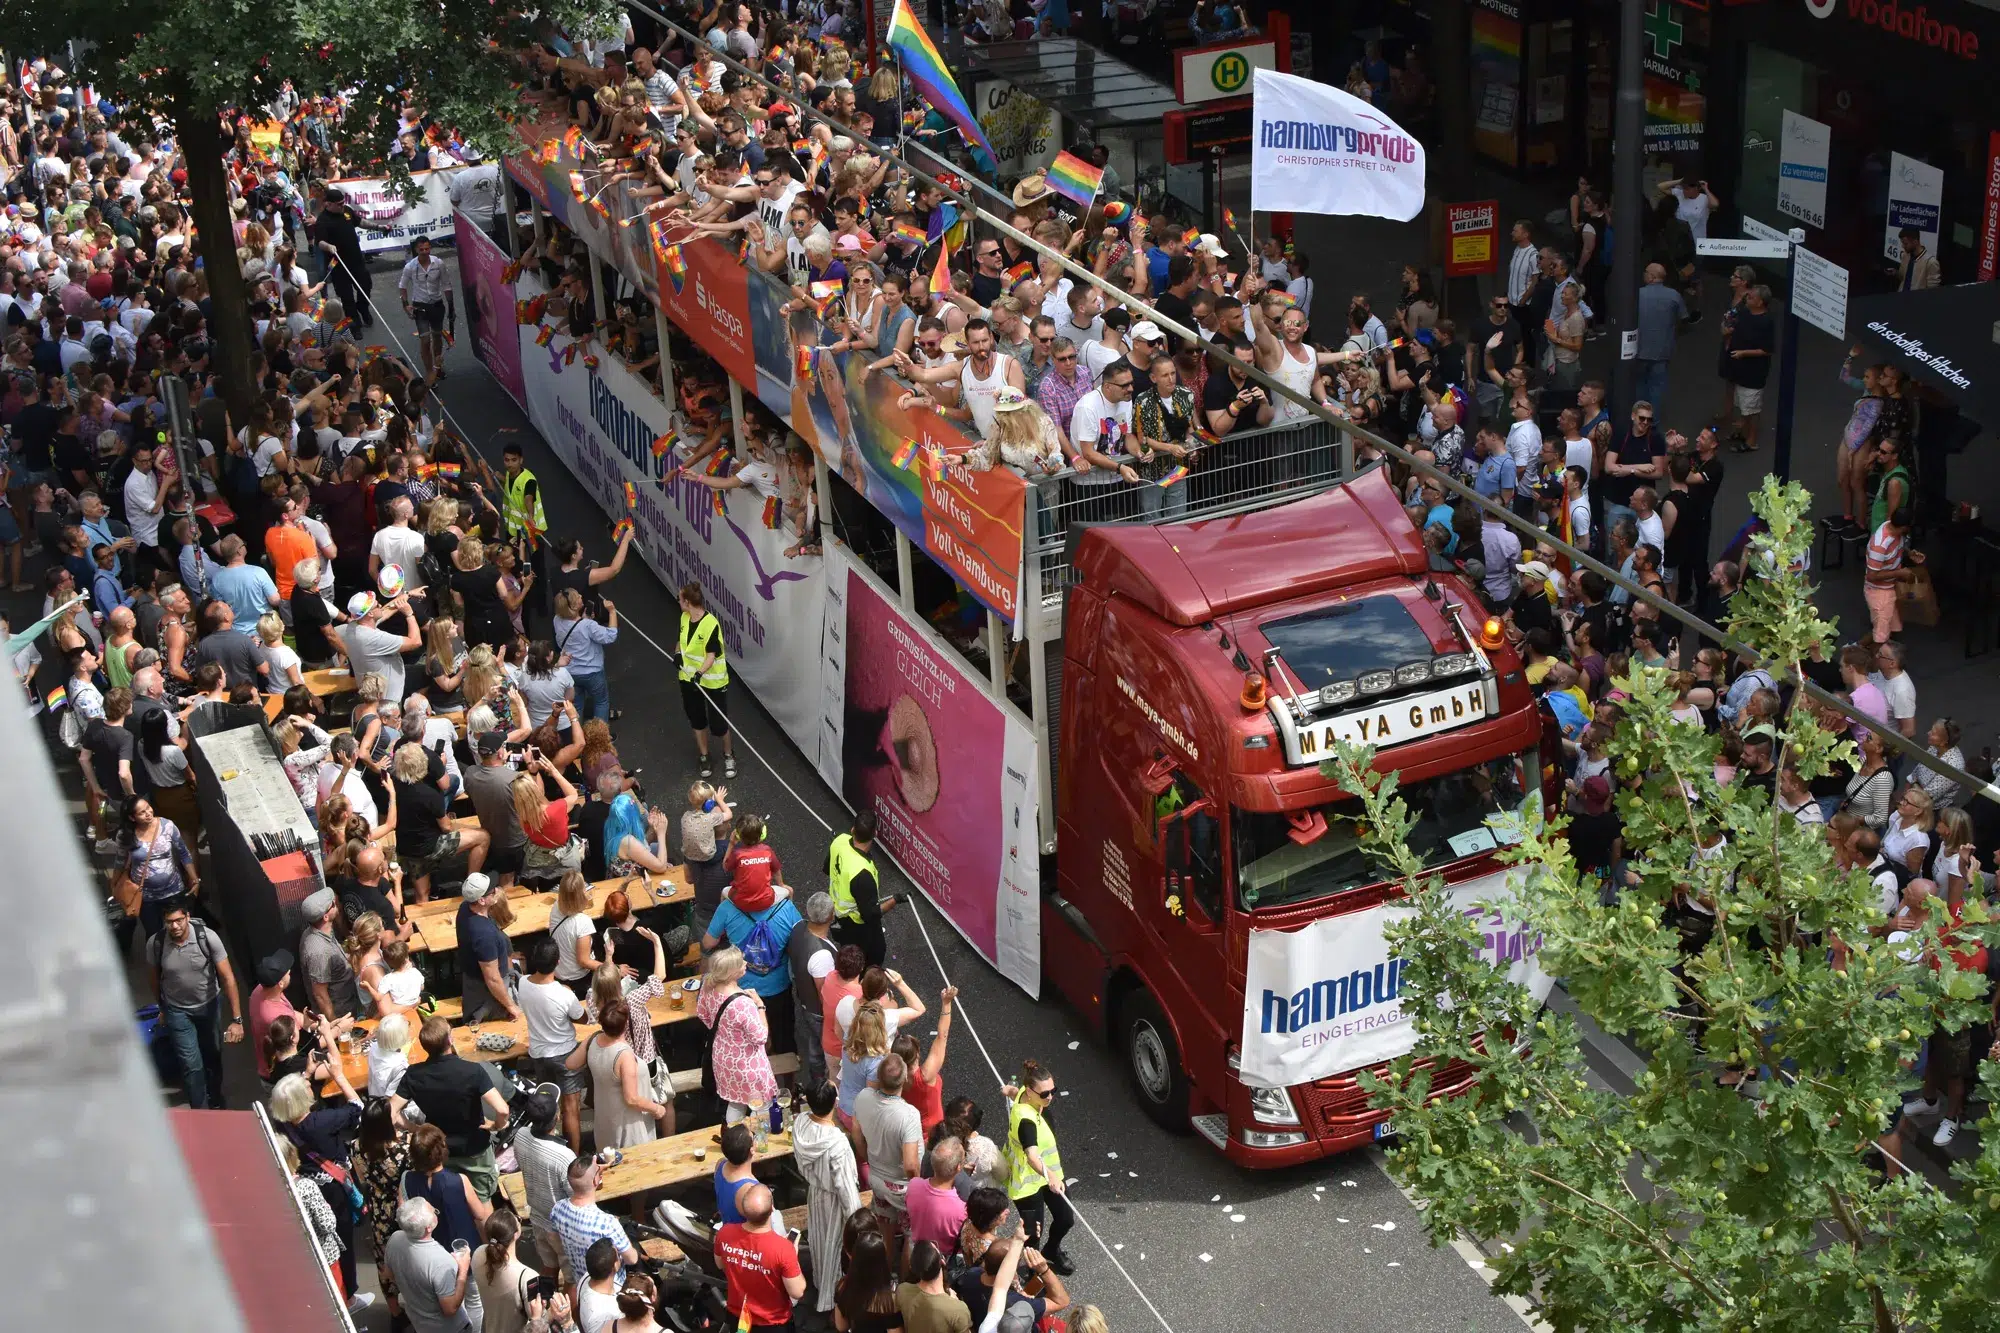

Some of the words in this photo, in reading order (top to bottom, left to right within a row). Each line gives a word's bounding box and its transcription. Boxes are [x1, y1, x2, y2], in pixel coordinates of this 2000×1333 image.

[1848, 0, 1980, 60] vodafone
[1643, 57, 1681, 80] HARMACY
[1260, 119, 1416, 164] hamburgpride
[1277, 155, 1341, 167] CHRISTOPHER
[1343, 158, 1377, 171] STREET
[1380, 164, 1396, 173] DAY
[1783, 165, 1791, 175] Zu
[1793, 167, 1825, 180] vermieten
[1989, 156, 2000, 198] Store
[354, 191, 369, 205] bin
[760, 200, 765, 219] I
[764, 205, 783, 229] AM
[1450, 207, 1476, 220] Hier
[1477, 205, 1493, 218] ist
[1780, 200, 1790, 211] 46
[1792, 204, 1801, 215] 09
[1803, 209, 1811, 220] 16
[1812, 213, 1822, 225] 46
[1455, 222, 1466, 231] DIE
[1983, 201, 1998, 271] Business
[790, 252, 795, 270] I
[1710, 243, 1747, 252] Außenalster
[1887, 246, 1898, 258] 46
[708, 291, 744, 338] Haspa
[1867, 321, 1889, 334] ein
[1881, 330, 1932, 362] schattiges
[556, 395, 587, 451] fordert
[588, 432, 602, 466] die
[675, 525, 744, 632] Gleichstellung
[747, 606, 765, 648] für
[927, 477, 949, 514] Voll
[949, 496, 975, 535] frei.
[657, 542, 674, 578] und
[931, 521, 953, 557] Voll
[954, 542, 1017, 611] Hamburg.
[887, 620, 956, 694] GRUNDSÄTZLICH
[896, 650, 943, 710] GLEICH
[1116, 674, 1199, 761] www.maya-gmbh.de
[1409, 688, 1483, 729] GmbH
[875, 794, 890, 820] FÜR
[891, 812, 911, 842] EINE
[912, 834, 951, 882] BESSERE
[740, 857, 771, 866] PORTUGAL
[874, 811, 952, 905] VERFASSUNG
[721, 1242, 763, 1261] Vorspiel
[741, 1259, 771, 1275] Berlin
